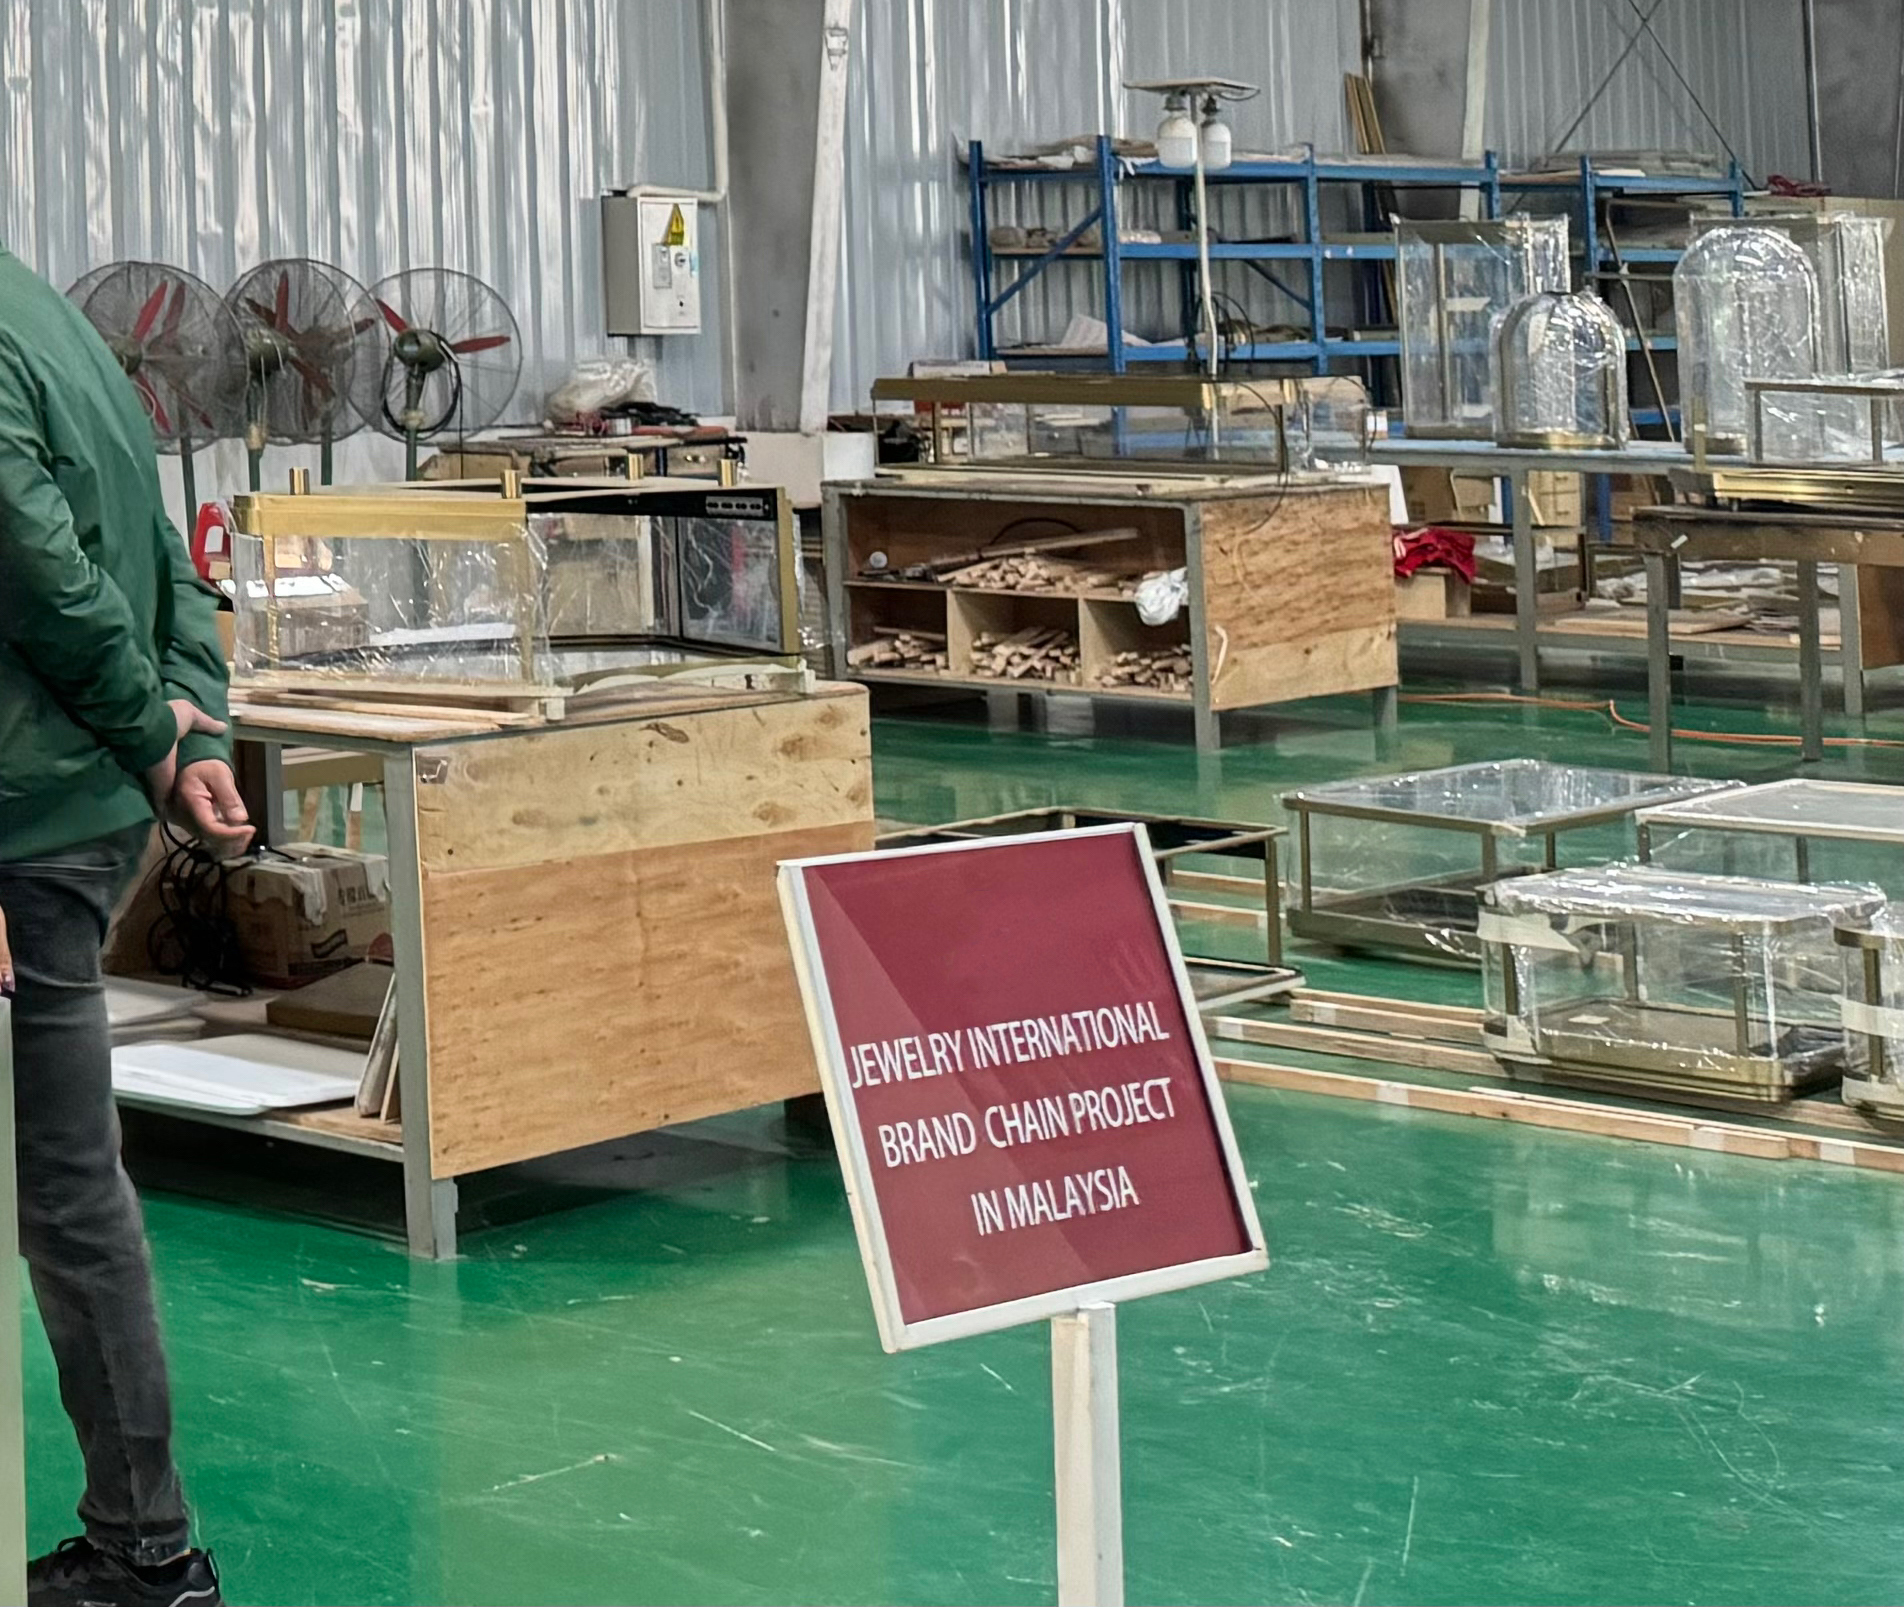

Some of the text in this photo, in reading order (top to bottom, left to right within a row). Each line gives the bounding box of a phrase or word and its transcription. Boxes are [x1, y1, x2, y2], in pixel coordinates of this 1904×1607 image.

[850, 1000, 1170, 1089] JEWELRY INTERNATIONAL
[878, 1077, 1175, 1168] BRAND CHAIN PROJECT
[970, 1165, 1140, 1236] IN MALAYSIA
